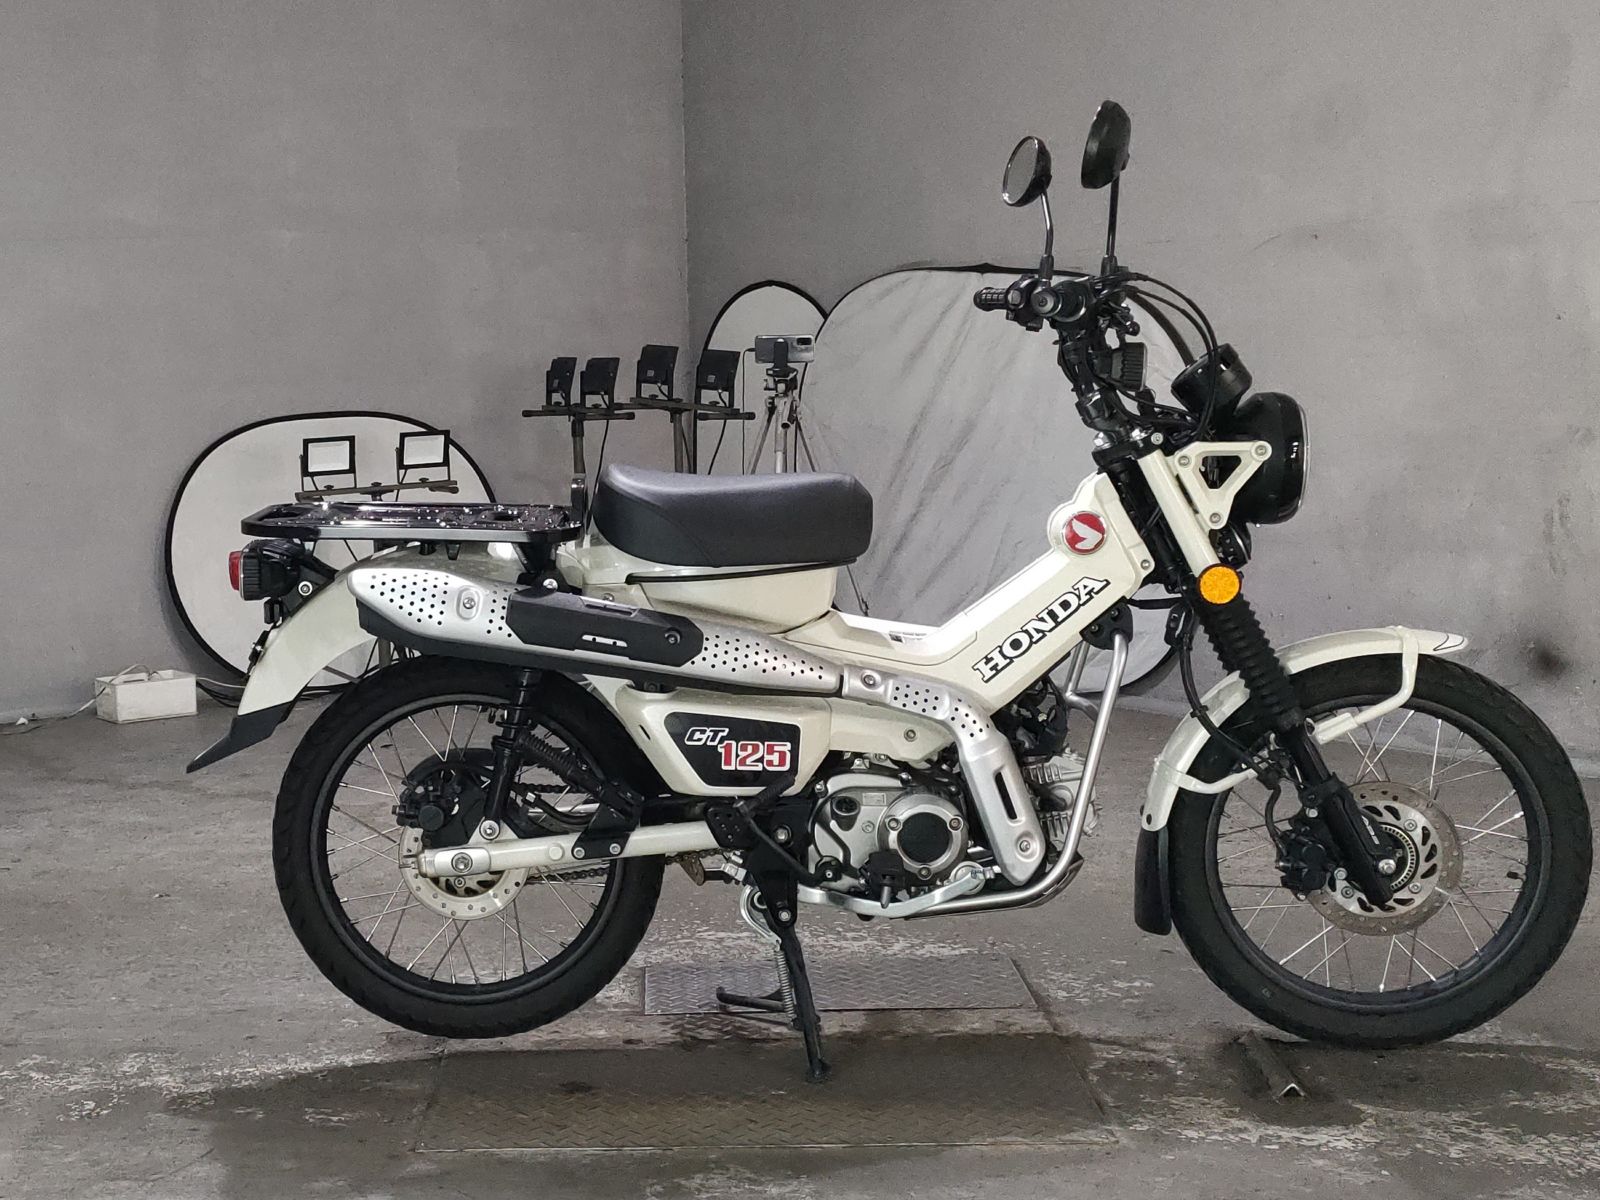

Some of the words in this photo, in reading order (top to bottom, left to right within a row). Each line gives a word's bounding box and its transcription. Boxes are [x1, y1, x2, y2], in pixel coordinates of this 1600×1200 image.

[972, 576, 1111, 683] HONDA
[685, 727, 729, 745] CT
[718, 741, 791, 771] 125
